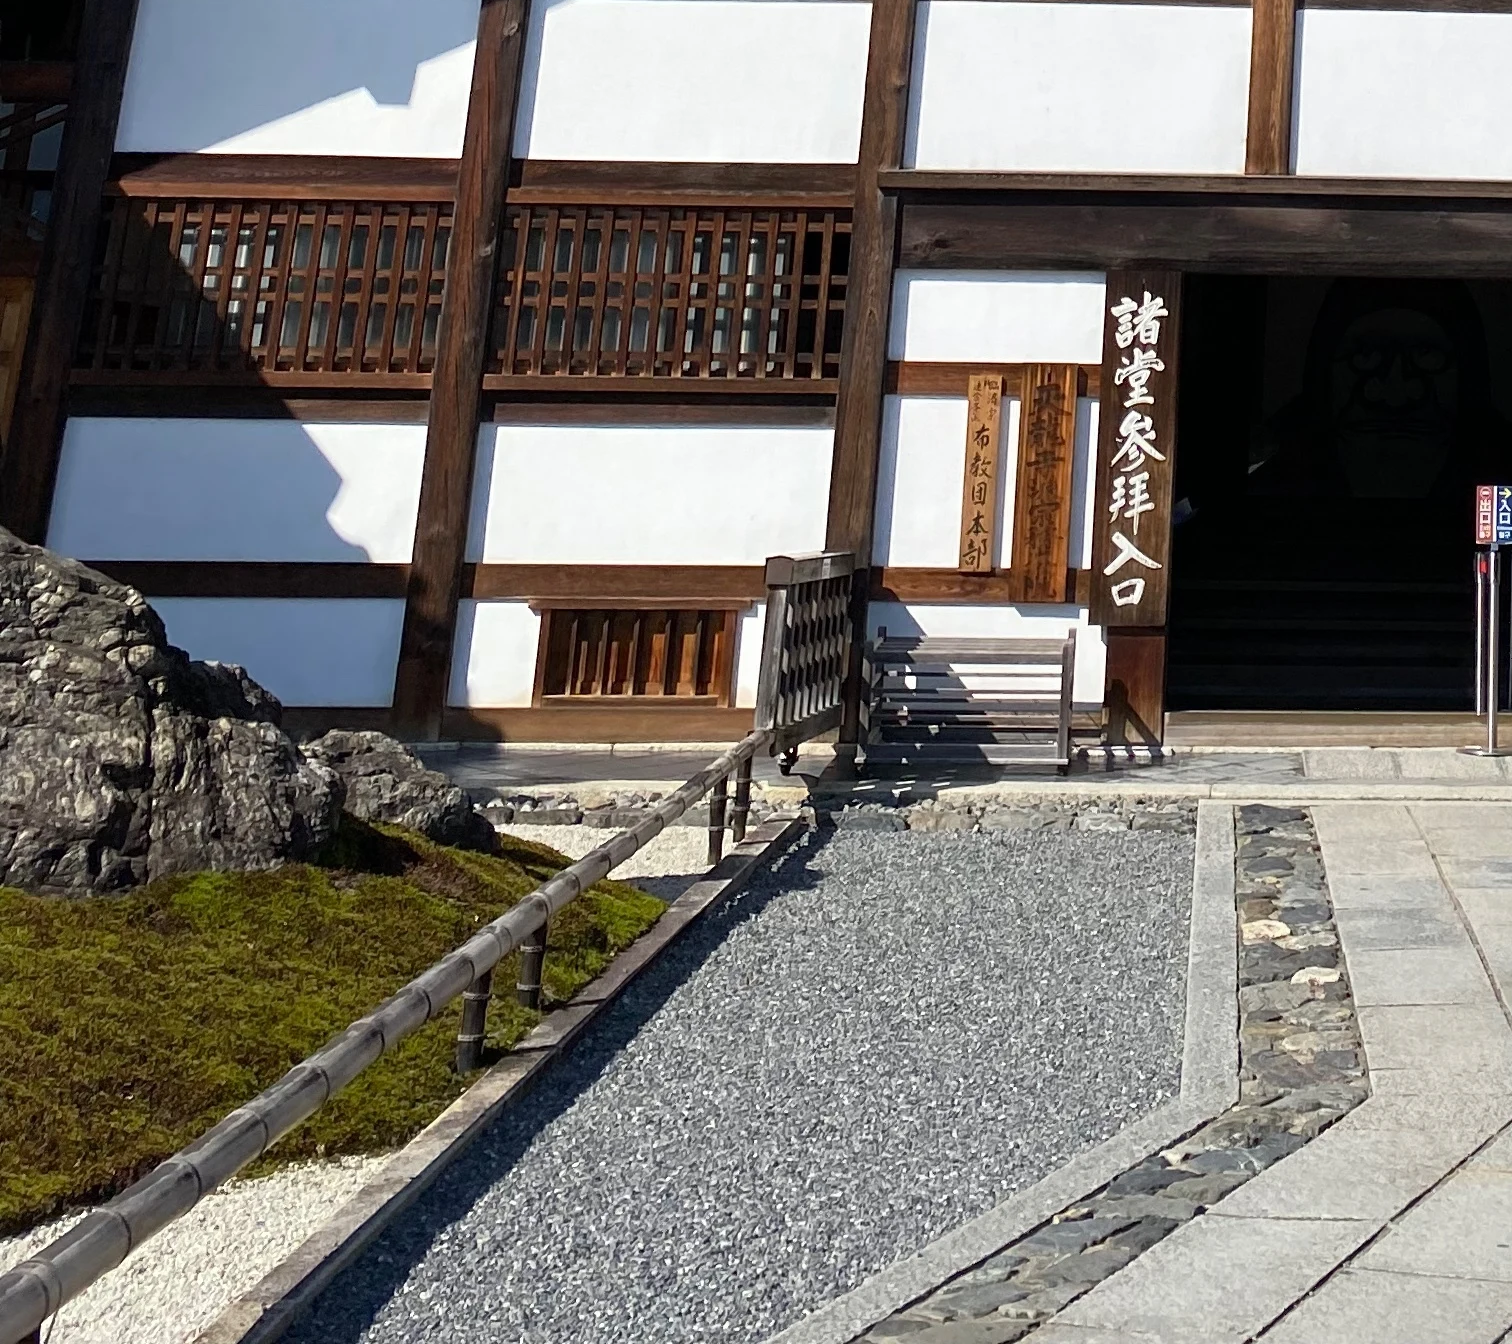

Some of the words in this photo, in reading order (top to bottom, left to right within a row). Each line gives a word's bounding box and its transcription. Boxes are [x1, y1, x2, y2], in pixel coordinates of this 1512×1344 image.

[963, 424, 992, 570] 布教団本部
[1480, 499, 1491, 524] 出口
[1499, 499, 1511, 524] 入口
